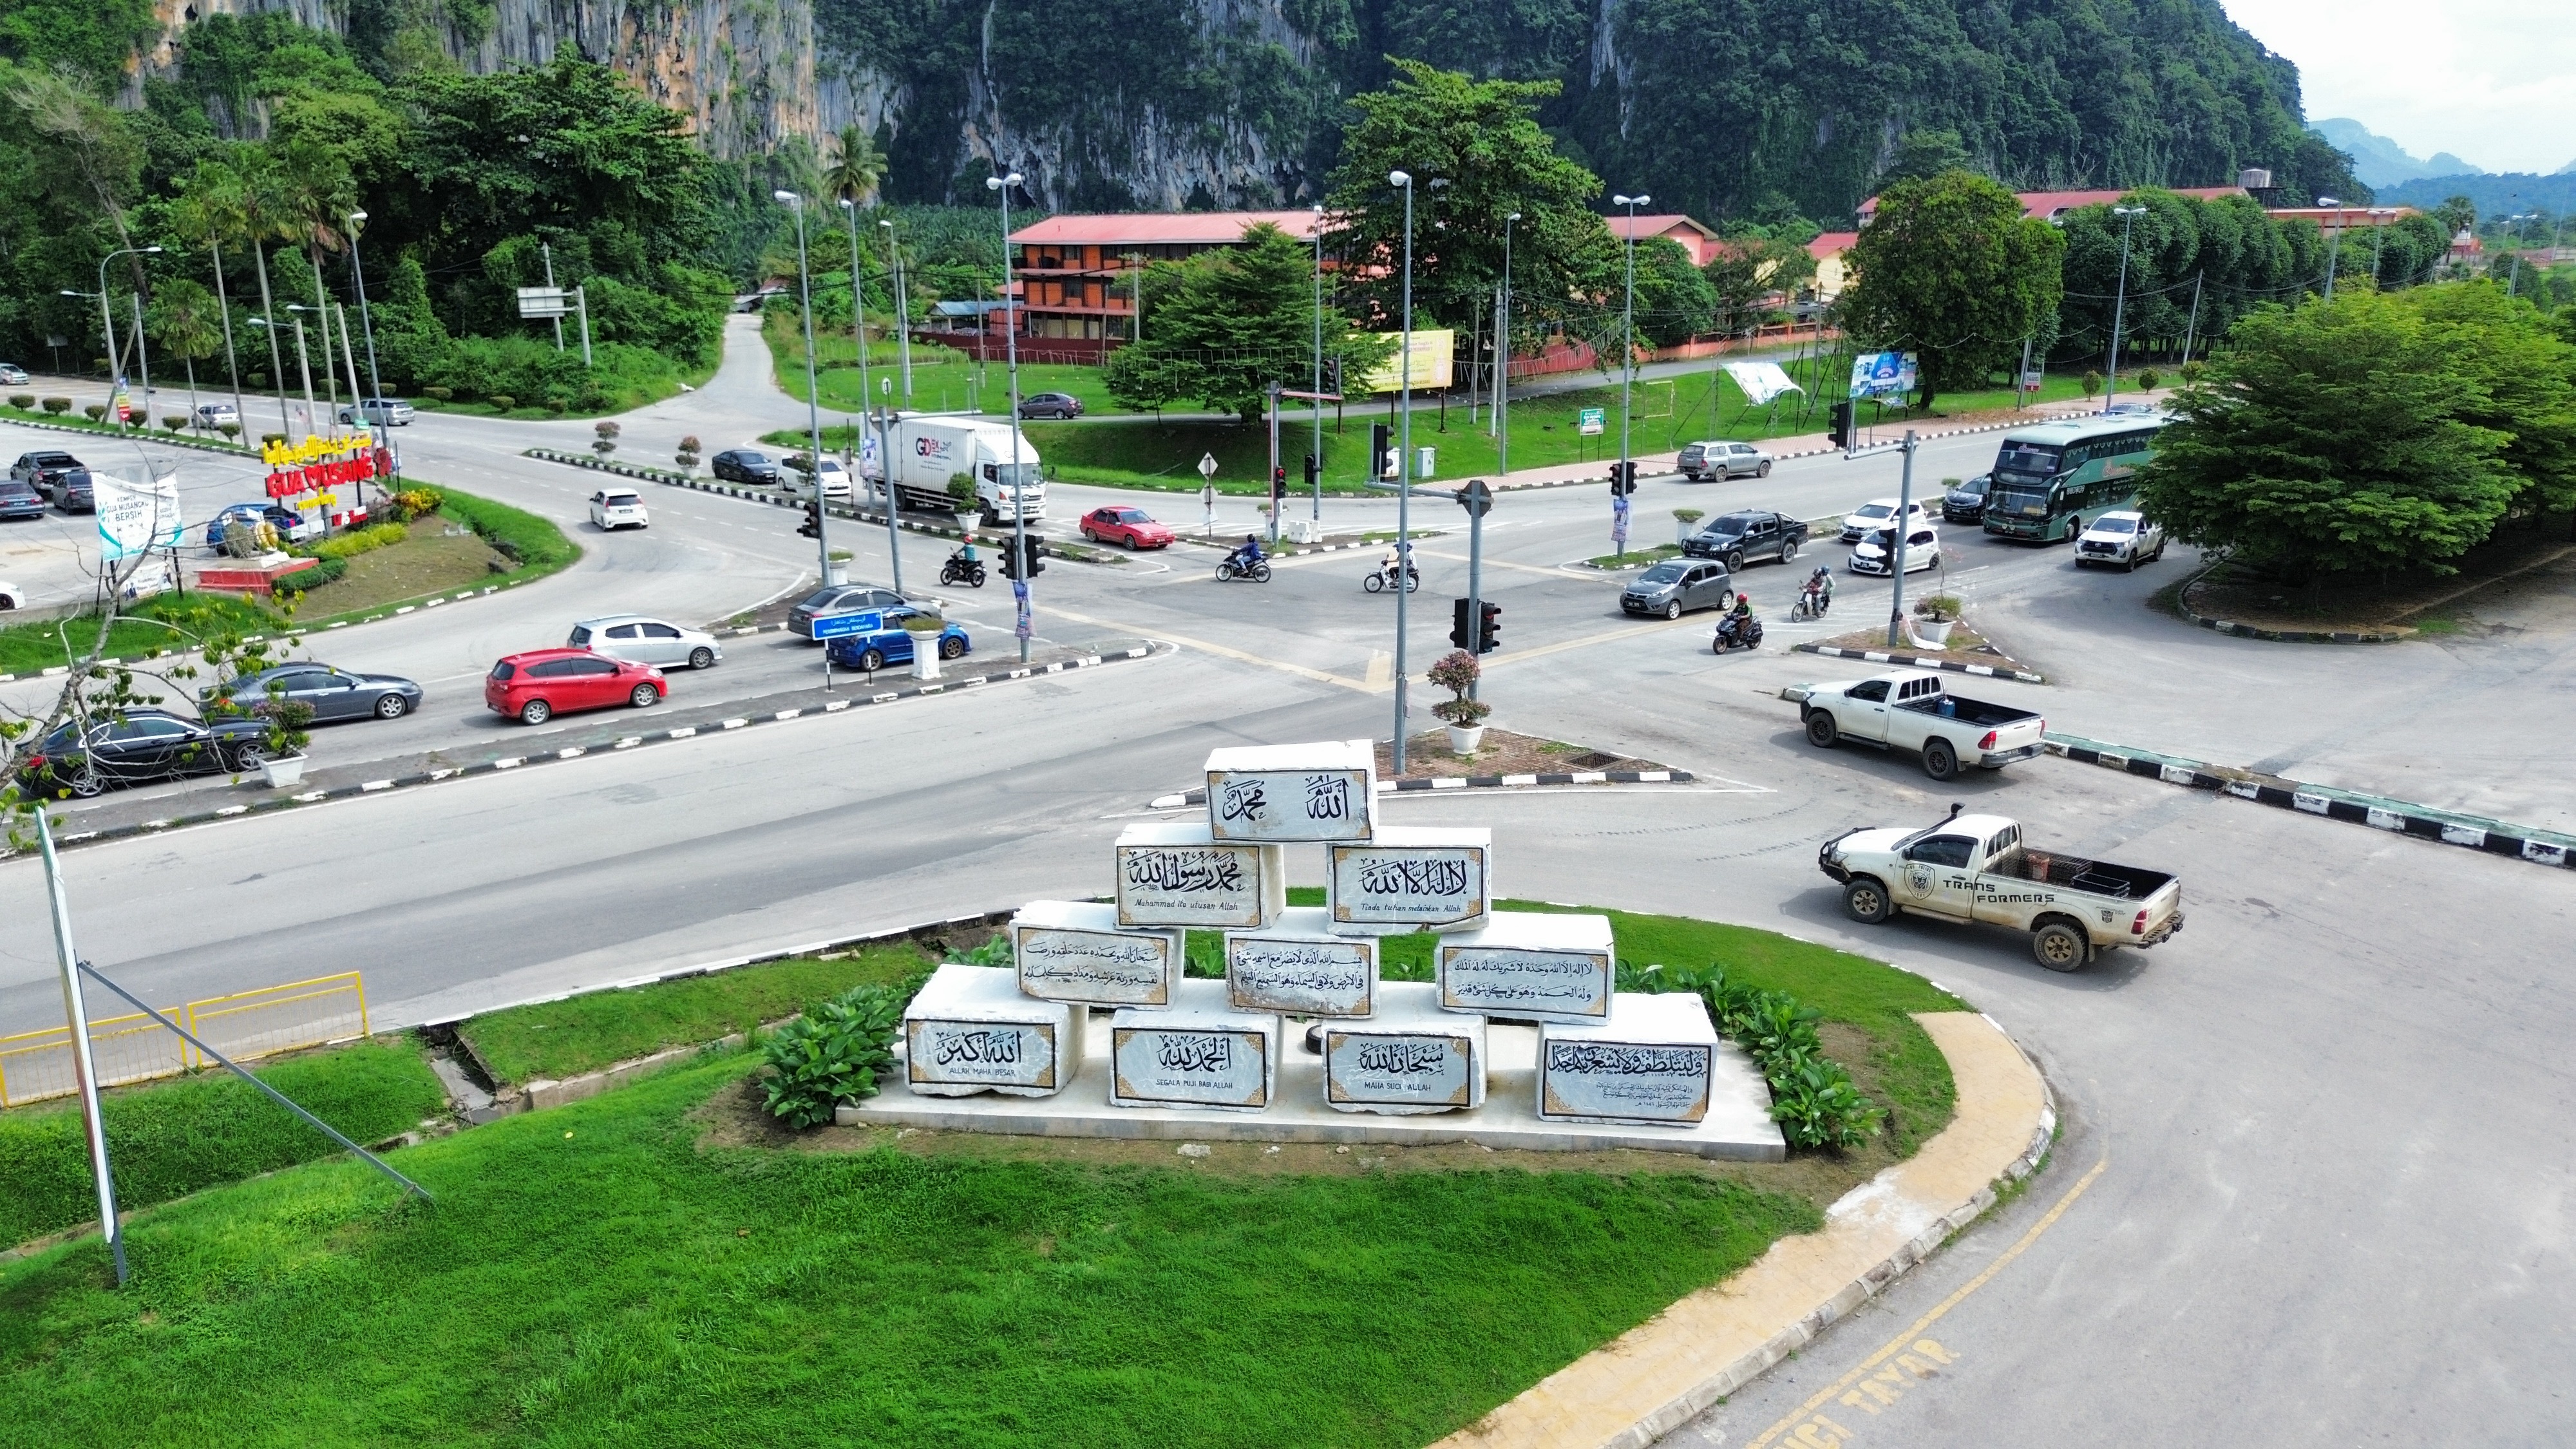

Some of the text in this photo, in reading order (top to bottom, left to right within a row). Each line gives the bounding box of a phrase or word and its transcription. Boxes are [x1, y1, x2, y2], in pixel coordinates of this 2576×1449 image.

[267, 470, 306, 499] GUA
[115, 510, 142, 522] BERSIH
[1223, 775, 1349, 823] الله محمد
[1977, 894, 2054, 903] FORMERS
[1135, 899, 1175, 907] Muhammad
[1218, 902, 1238, 911] Allah
[1361, 903, 1380, 911] Tiada
[1385, 903, 1406, 911] tuhan
[1443, 904, 1461, 913] Allah
[996, 1068, 1016, 1077] BESAR
[1839, 1339, 1960, 1416] TAYAR
